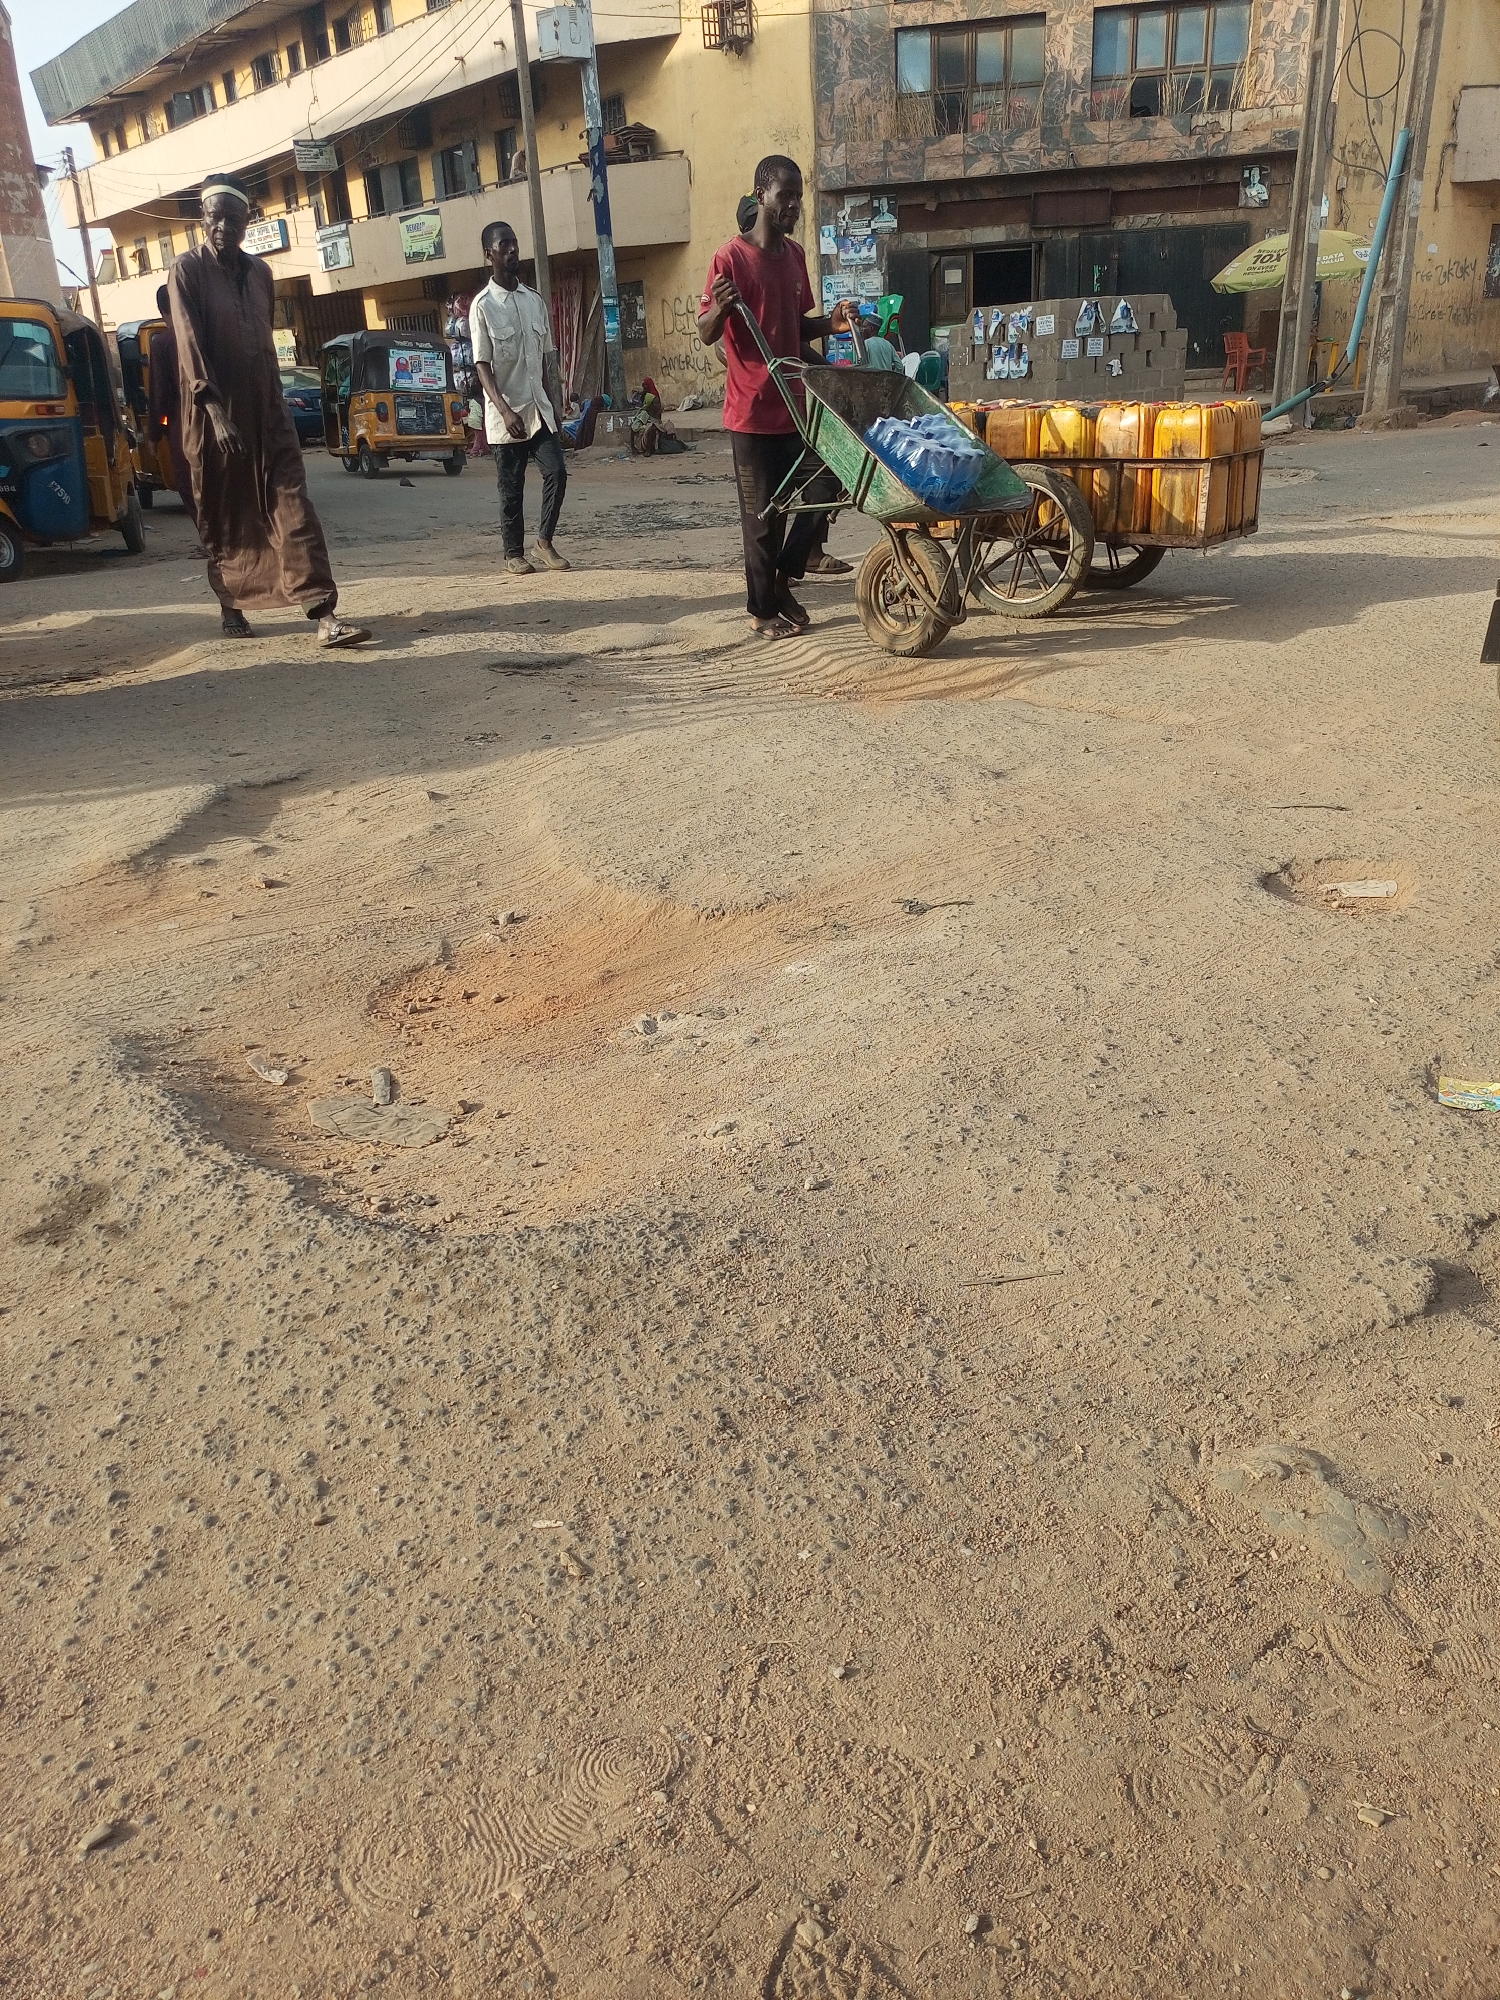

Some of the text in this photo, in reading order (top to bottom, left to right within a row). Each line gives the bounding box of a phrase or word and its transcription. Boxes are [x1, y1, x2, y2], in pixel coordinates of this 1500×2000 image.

[1252, 251, 1288, 265] 10X
[1321, 256, 1345, 265] VALUE
[1322, 251, 1344, 261] DATA
[682, 331, 701, 355] TO
